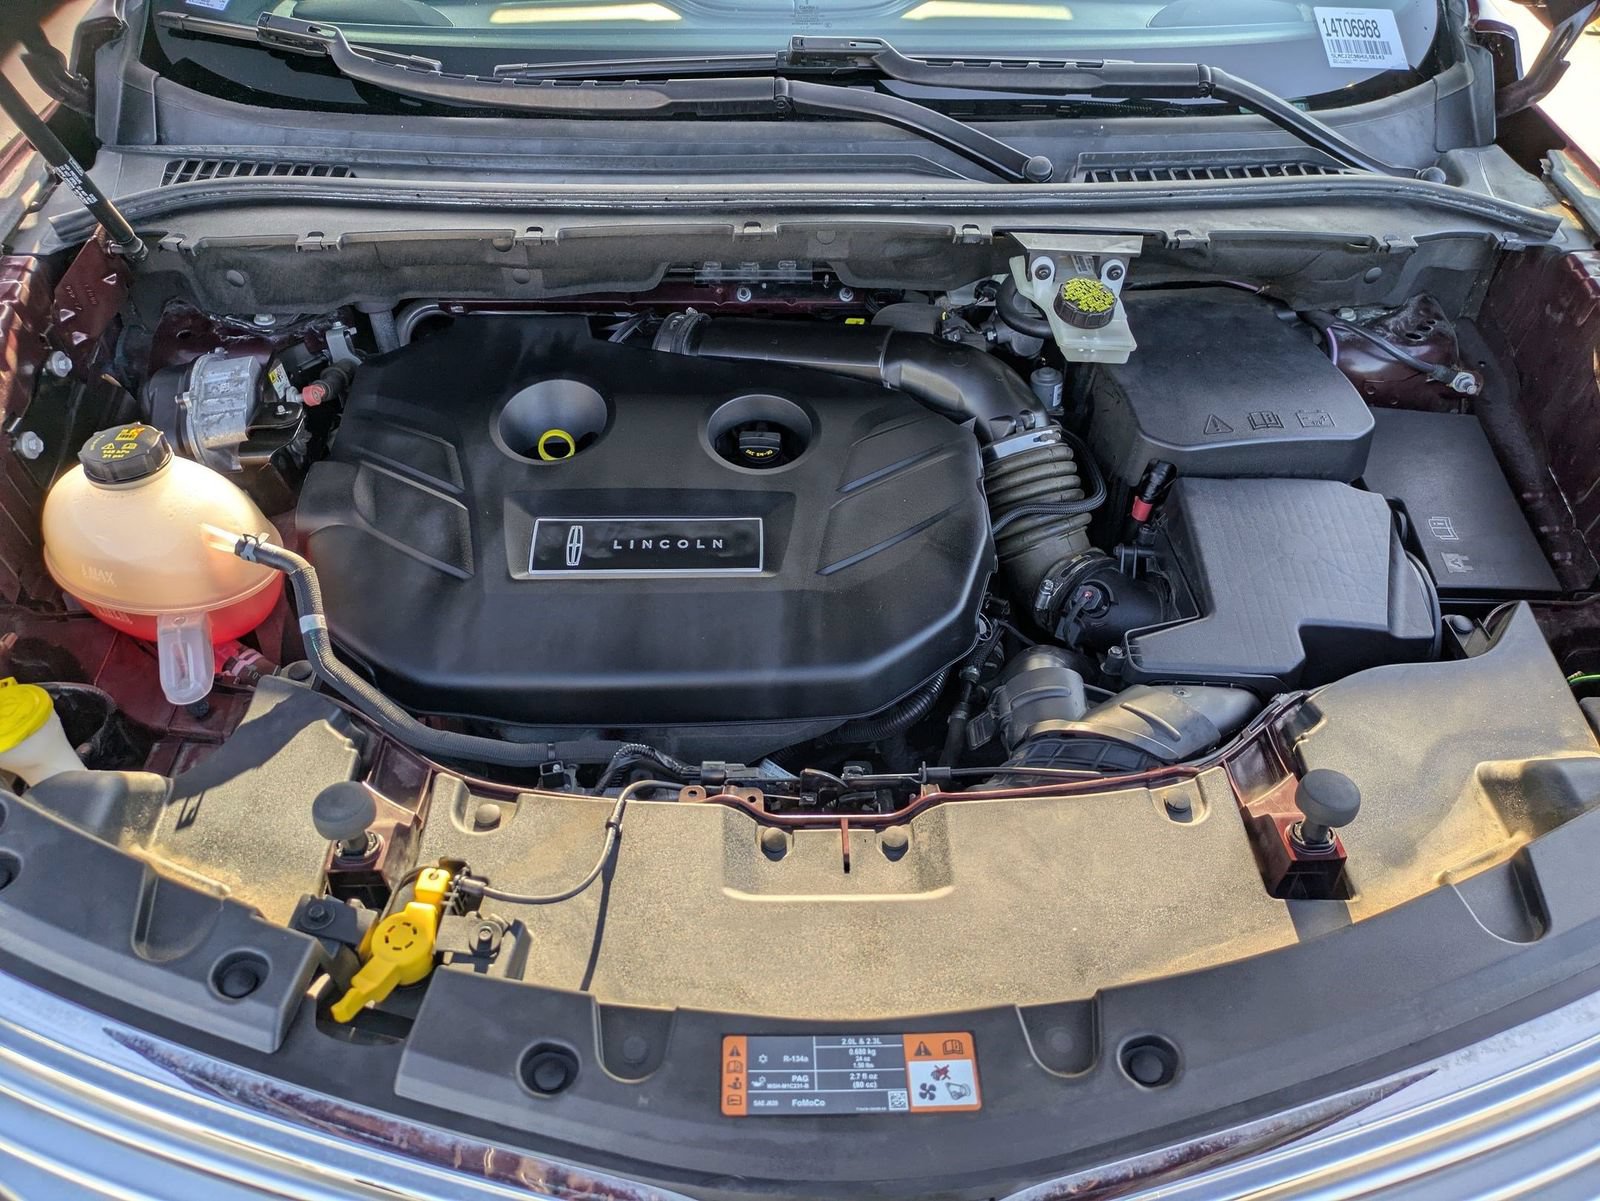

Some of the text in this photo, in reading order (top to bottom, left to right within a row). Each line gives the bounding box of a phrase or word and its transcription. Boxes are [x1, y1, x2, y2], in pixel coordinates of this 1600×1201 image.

[1322, 17, 1381, 39] 14T06968
[613, 539, 723, 550] LINCOLN
[867, 1048, 877, 1057] kg
[783, 1055, 809, 1063] R-134a
[865, 1081, 878, 1089] cc)
[791, 1099, 826, 1107] FoMoCo
